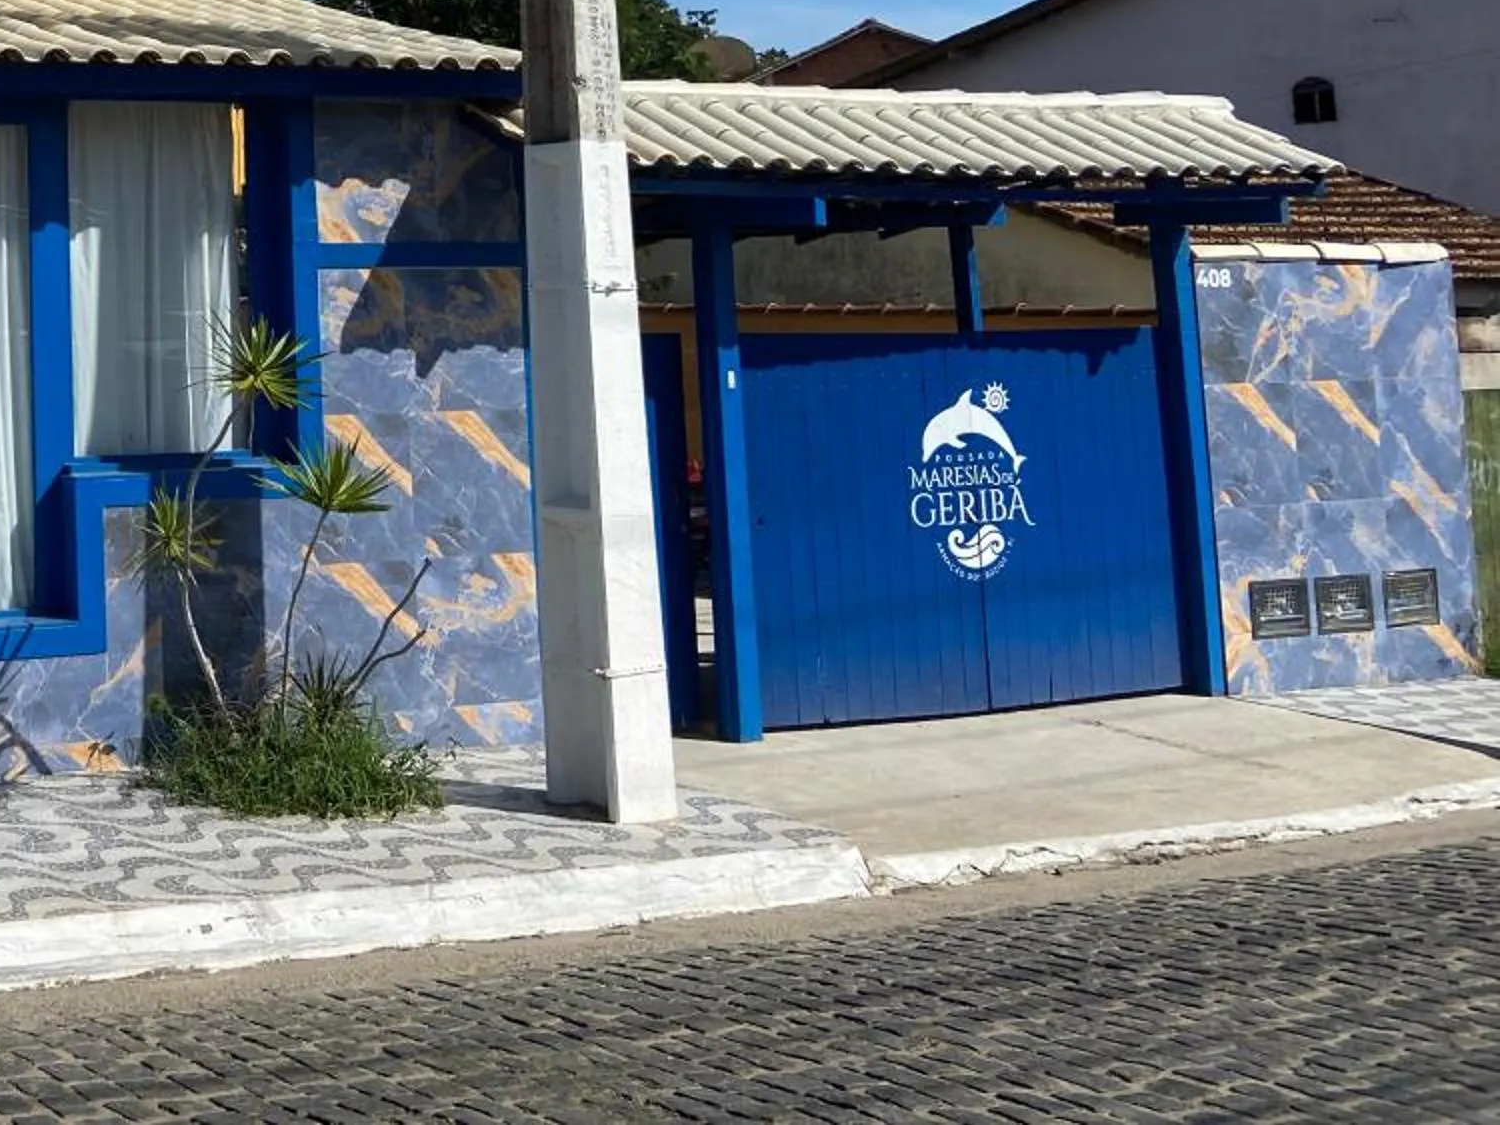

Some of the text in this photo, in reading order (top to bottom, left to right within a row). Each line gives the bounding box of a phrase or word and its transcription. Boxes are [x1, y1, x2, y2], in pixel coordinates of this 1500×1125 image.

[1196, 268, 1232, 288] 408
[934, 451, 1005, 463] POUSADA
[908, 463, 1000, 491] MARESIAS
[911, 478, 1036, 528] GERIBÁ
